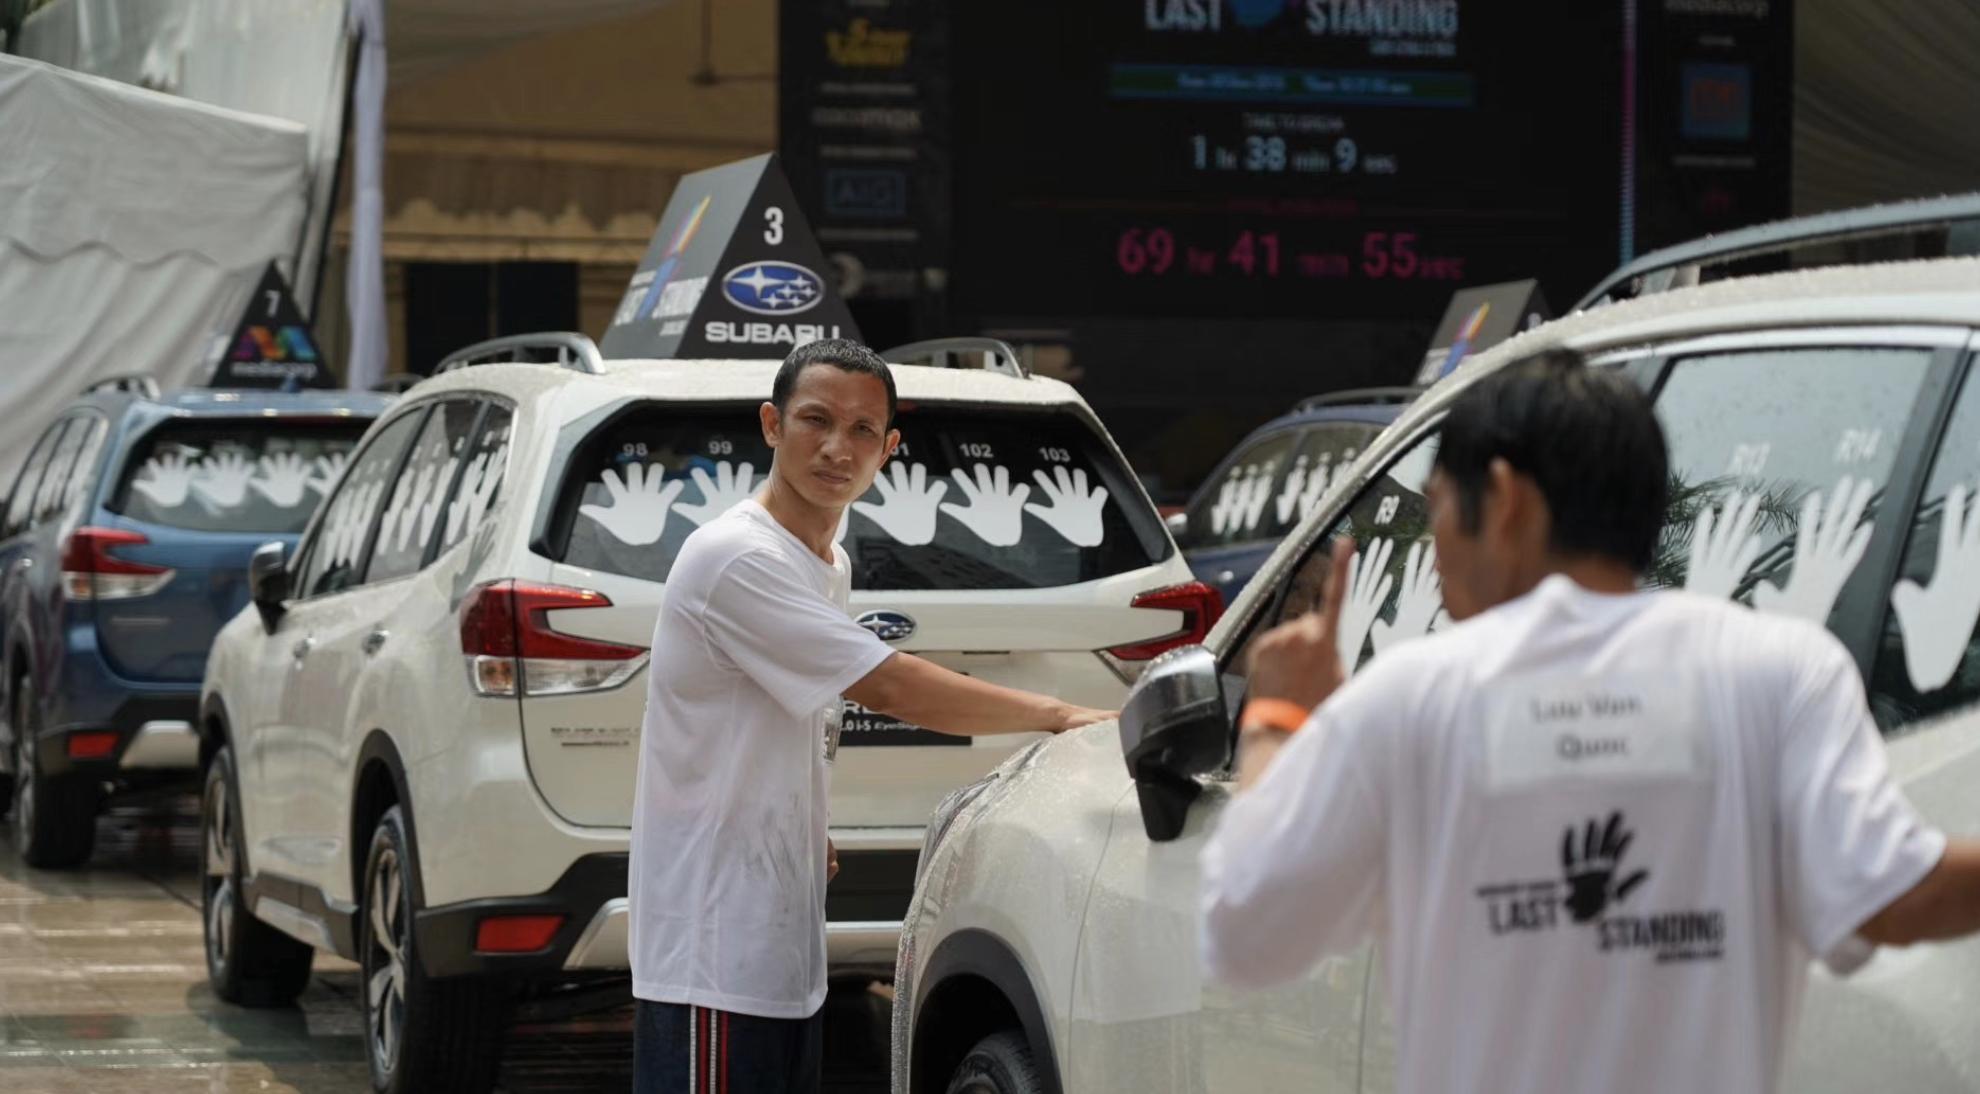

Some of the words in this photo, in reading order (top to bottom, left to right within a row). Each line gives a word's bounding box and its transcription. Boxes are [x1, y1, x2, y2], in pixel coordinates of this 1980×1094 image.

[1145, 0, 1220, 31] LAST
[1305, 0, 1458, 36] STANDING
[1191, 135, 1207, 170] 1
[1246, 135, 1287, 171] 38
[1334, 138, 1357, 172] 9
[764, 206, 784, 245] 3
[1116, 227, 1176, 275] 69
[1228, 229, 1281, 277] 41
[704, 321, 840, 344] SUBARU
[623, 443, 648, 457] 98
[708, 441, 733, 455] 99
[891, 444, 910, 457] 01
[959, 443, 994, 459] 102
[1039, 447, 1071, 463] 103
[1489, 900, 1557, 934] LAST
[1599, 911, 1724, 951] STANDING
